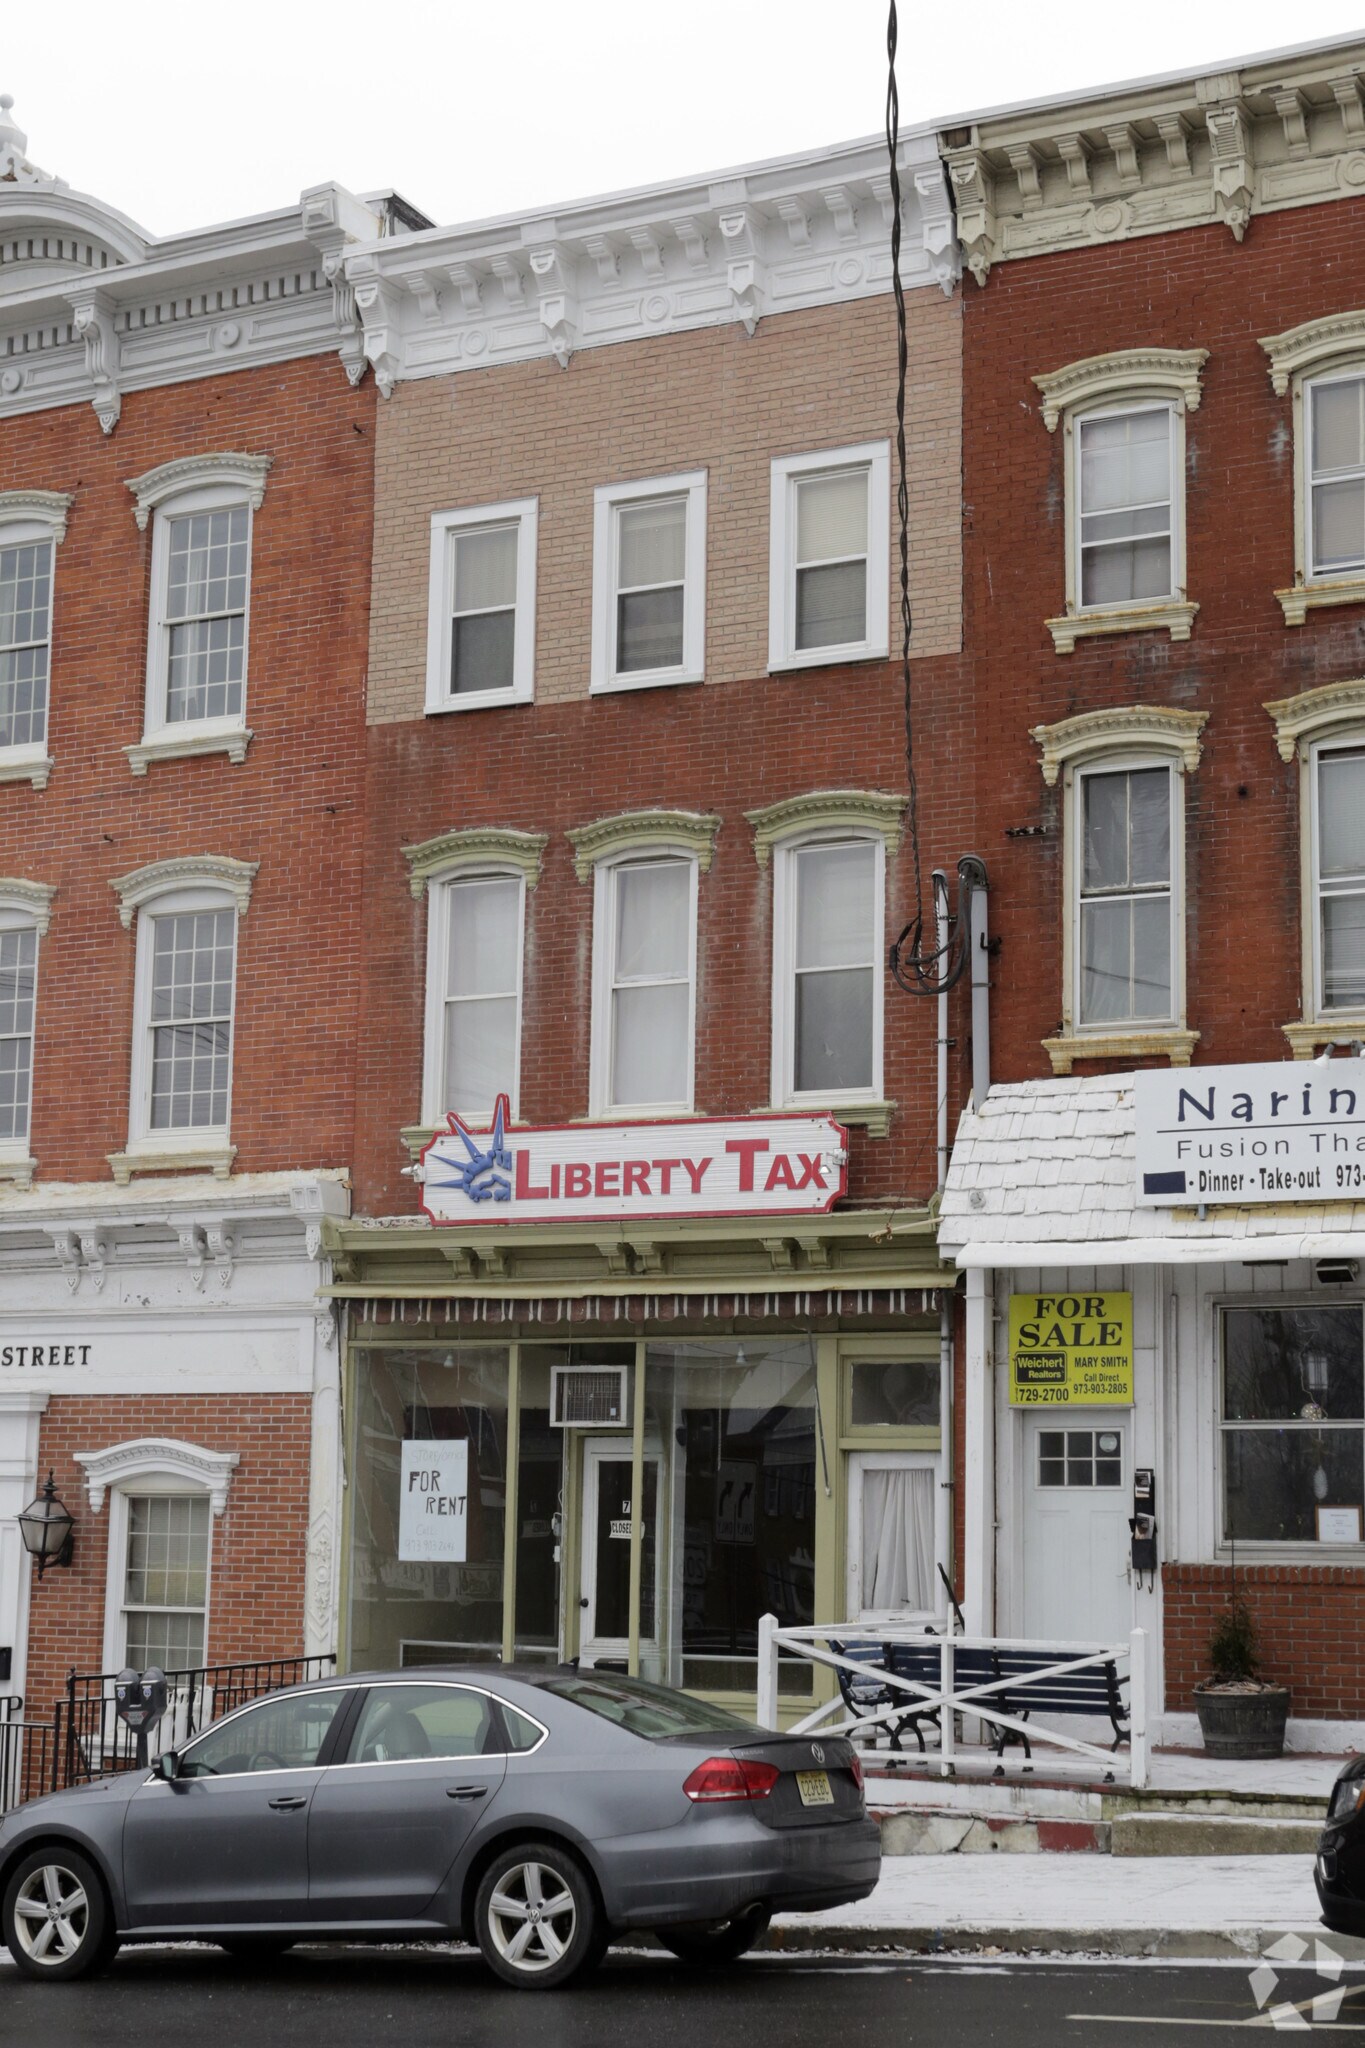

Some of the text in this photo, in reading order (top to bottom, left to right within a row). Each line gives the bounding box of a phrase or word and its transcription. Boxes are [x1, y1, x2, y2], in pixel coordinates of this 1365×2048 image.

[1178, 1083, 1356, 1122] Narin
[1177, 1137, 1290, 1159] Fusion
[515, 1138, 829, 1200] LIBERTY TAX
[1199, 1169, 1244, 1193] Dinner
[1259, 1166, 1321, 1190] Take-out
[1033, 1297, 1107, 1319] FOR
[1018, 1322, 1123, 1348] SALE
[1, 1345, 92, 1367] STREET
[1017, 1357, 1064, 1368] Weichert
[1074, 1356, 1128, 1368] MARY SMITH
[1028, 1370, 1062, 1379] Realtors
[1084, 1373, 1120, 1382] Call Direct
[1018, 1388, 1069, 1402] 729-2700
[1073, 1383, 1128, 1394] 973-903-2805
[408, 1470, 441, 1493] FOR
[425, 1496, 467, 1516] RENT
